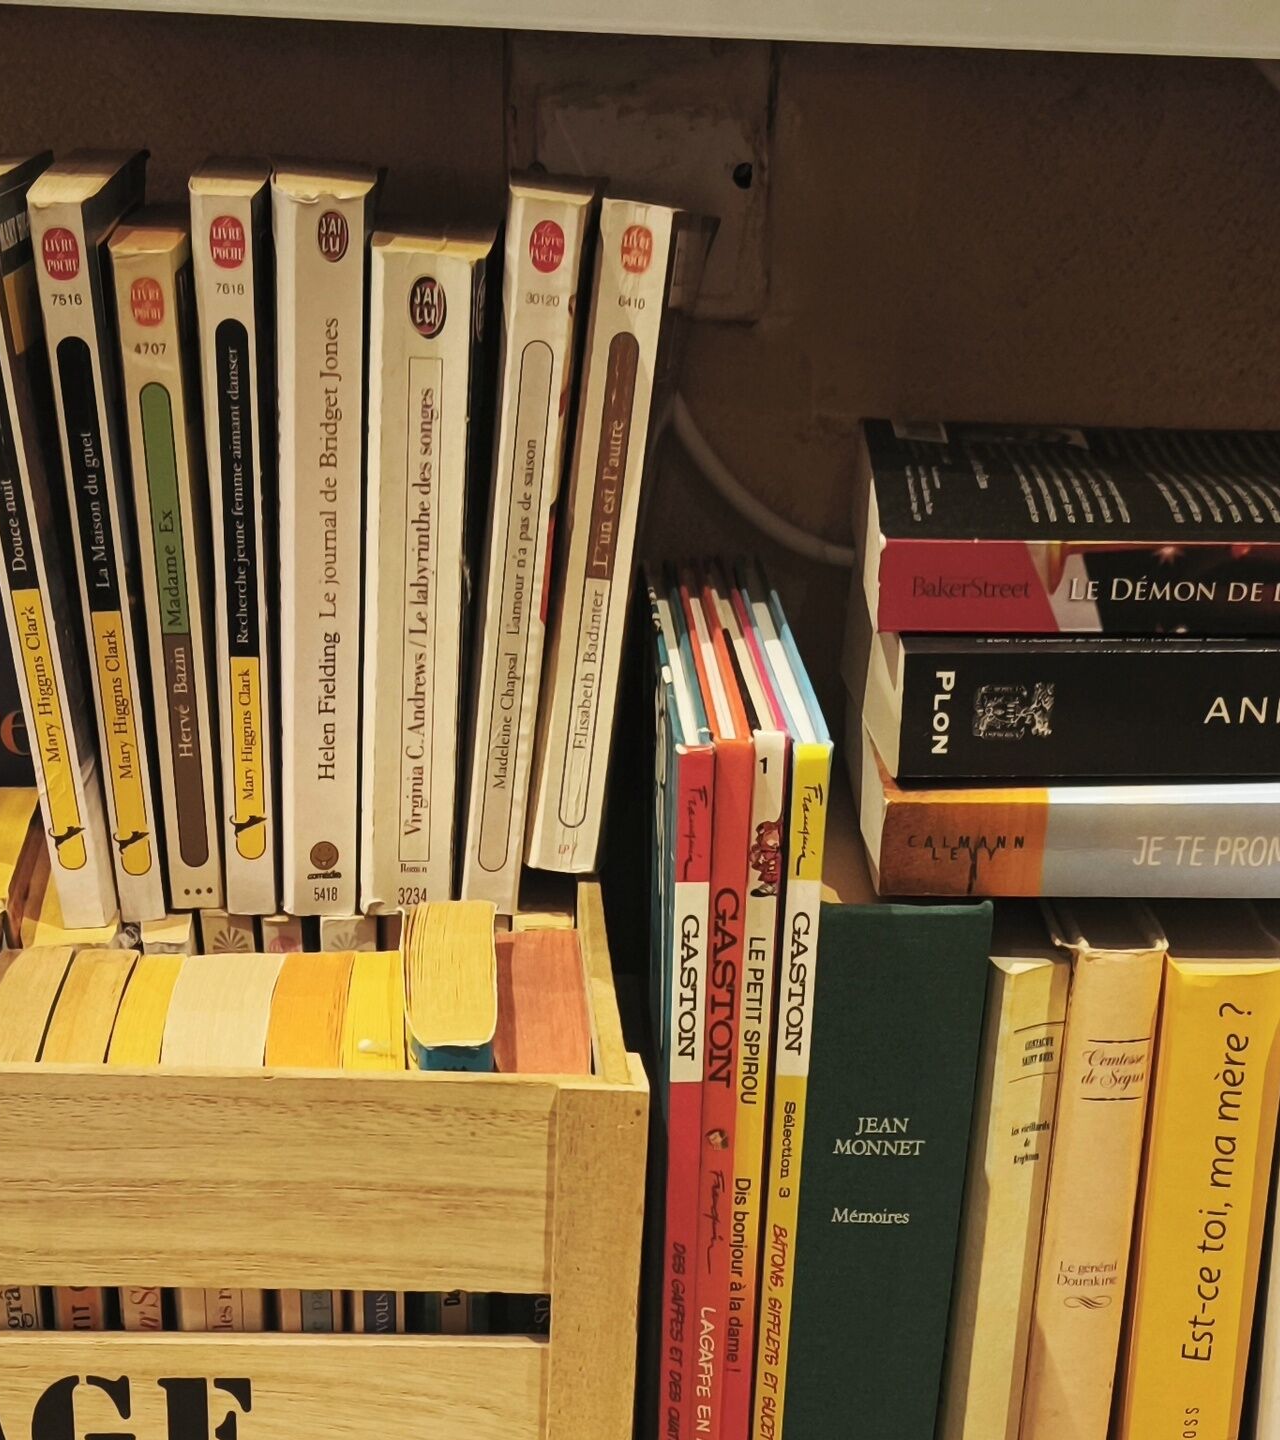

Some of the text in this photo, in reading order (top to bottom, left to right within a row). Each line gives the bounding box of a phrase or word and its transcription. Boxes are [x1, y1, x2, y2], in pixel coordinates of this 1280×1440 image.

[134, 343, 166, 355] 4707
[225, 346, 256, 801] Mary Higgins Clark danser
[318, 317, 342, 781] Helen Fielding Le journal de Bridget Jones
[912, 576, 1032, 599] BakerStreet
[0, 478, 61, 763] Mary Higgins Clark Douce nuit
[81, 431, 135, 780] Mary Higgins Clark La Maison du guet
[404, 388, 439, 836] Virginia Andrews Le labyrinthe des songes
[494, 439, 537, 789] Madeleine Chapsal L'amour pas saison
[1070, 577, 1099, 600] LE
[1111, 575, 1216, 601] DÉMON
[1228, 582, 1262, 602] DE
[159, 509, 194, 758] Hervé Bazin Madame Ex
[573, 590, 604, 750] Elisabeth Badinter
[931, 670, 956, 755] PLON
[907, 835, 1025, 849] CALMANN
[1132, 836, 1166, 867] JE
[1174, 836, 1207, 867] TE
[314, 887, 338, 901] 5418
[398, 887, 427, 905] 3234
[678, 914, 700, 1061] GASTON
[708, 887, 740, 1088] GASTON
[740, 936, 766, 1105] LE PETIT SPIROU
[785, 911, 811, 1056] GASTON
[1081, 1069, 1097, 1085] de
[1082, 1050, 1145, 1067] Comtesse
[780, 1101, 796, 1178] Sélection
[832, 1140, 926, 1156] MONNET
[855, 1117, 910, 1135] JEAN
[831, 1208, 910, 1225] Mémoires
[1181, 1032, 1250, 1363] Est-ce toi, ma mère
[727, 1178, 751, 1364] Dis bonjour dame
[1059, 1260, 1118, 1276] Le général
[696, 1307, 716, 1398] LAGAFFE
[762, 1299, 782, 1366] SIFFLETS
[694, 1405, 711, 1432] EN
[763, 1371, 778, 1394] ET
